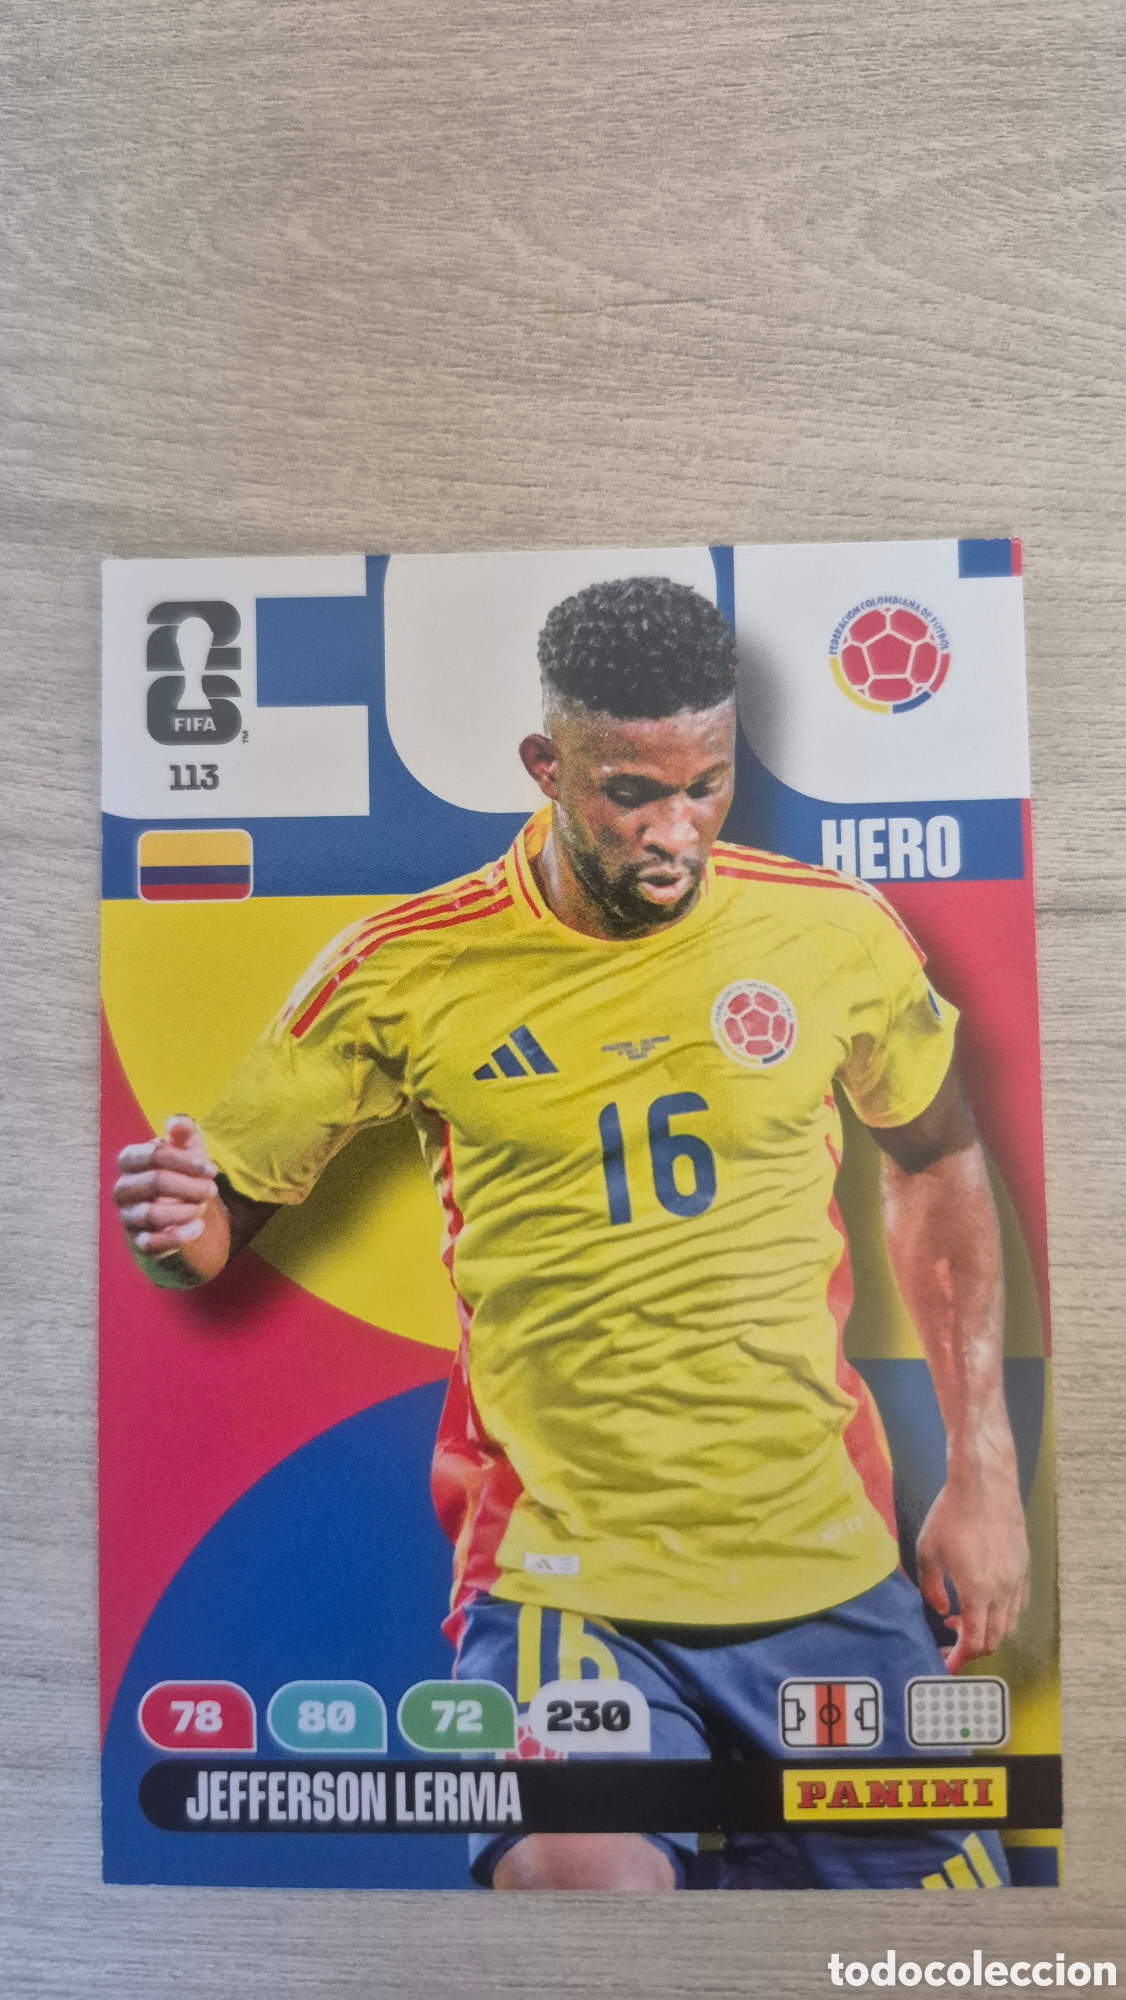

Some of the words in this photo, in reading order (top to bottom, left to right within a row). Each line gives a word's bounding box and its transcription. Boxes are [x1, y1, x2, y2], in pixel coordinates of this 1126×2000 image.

[860, 596, 921, 613] COLOMBIANA
[920, 607, 933, 620] DE
[174, 717, 217, 732] FIFA
[169, 764, 220, 791] 113
[821, 815, 961, 880] HERO
[598, 1091, 717, 1227] 16
[170, 1700, 223, 1733] 78
[298, 1700, 357, 1732] 80
[431, 1700, 483, 1733] 72
[546, 1700, 631, 1732] 230
[186, 1770, 387, 1822] JEFFERSON
[395, 1771, 523, 1822] LERMA
[797, 1778, 994, 1809] PANINI
